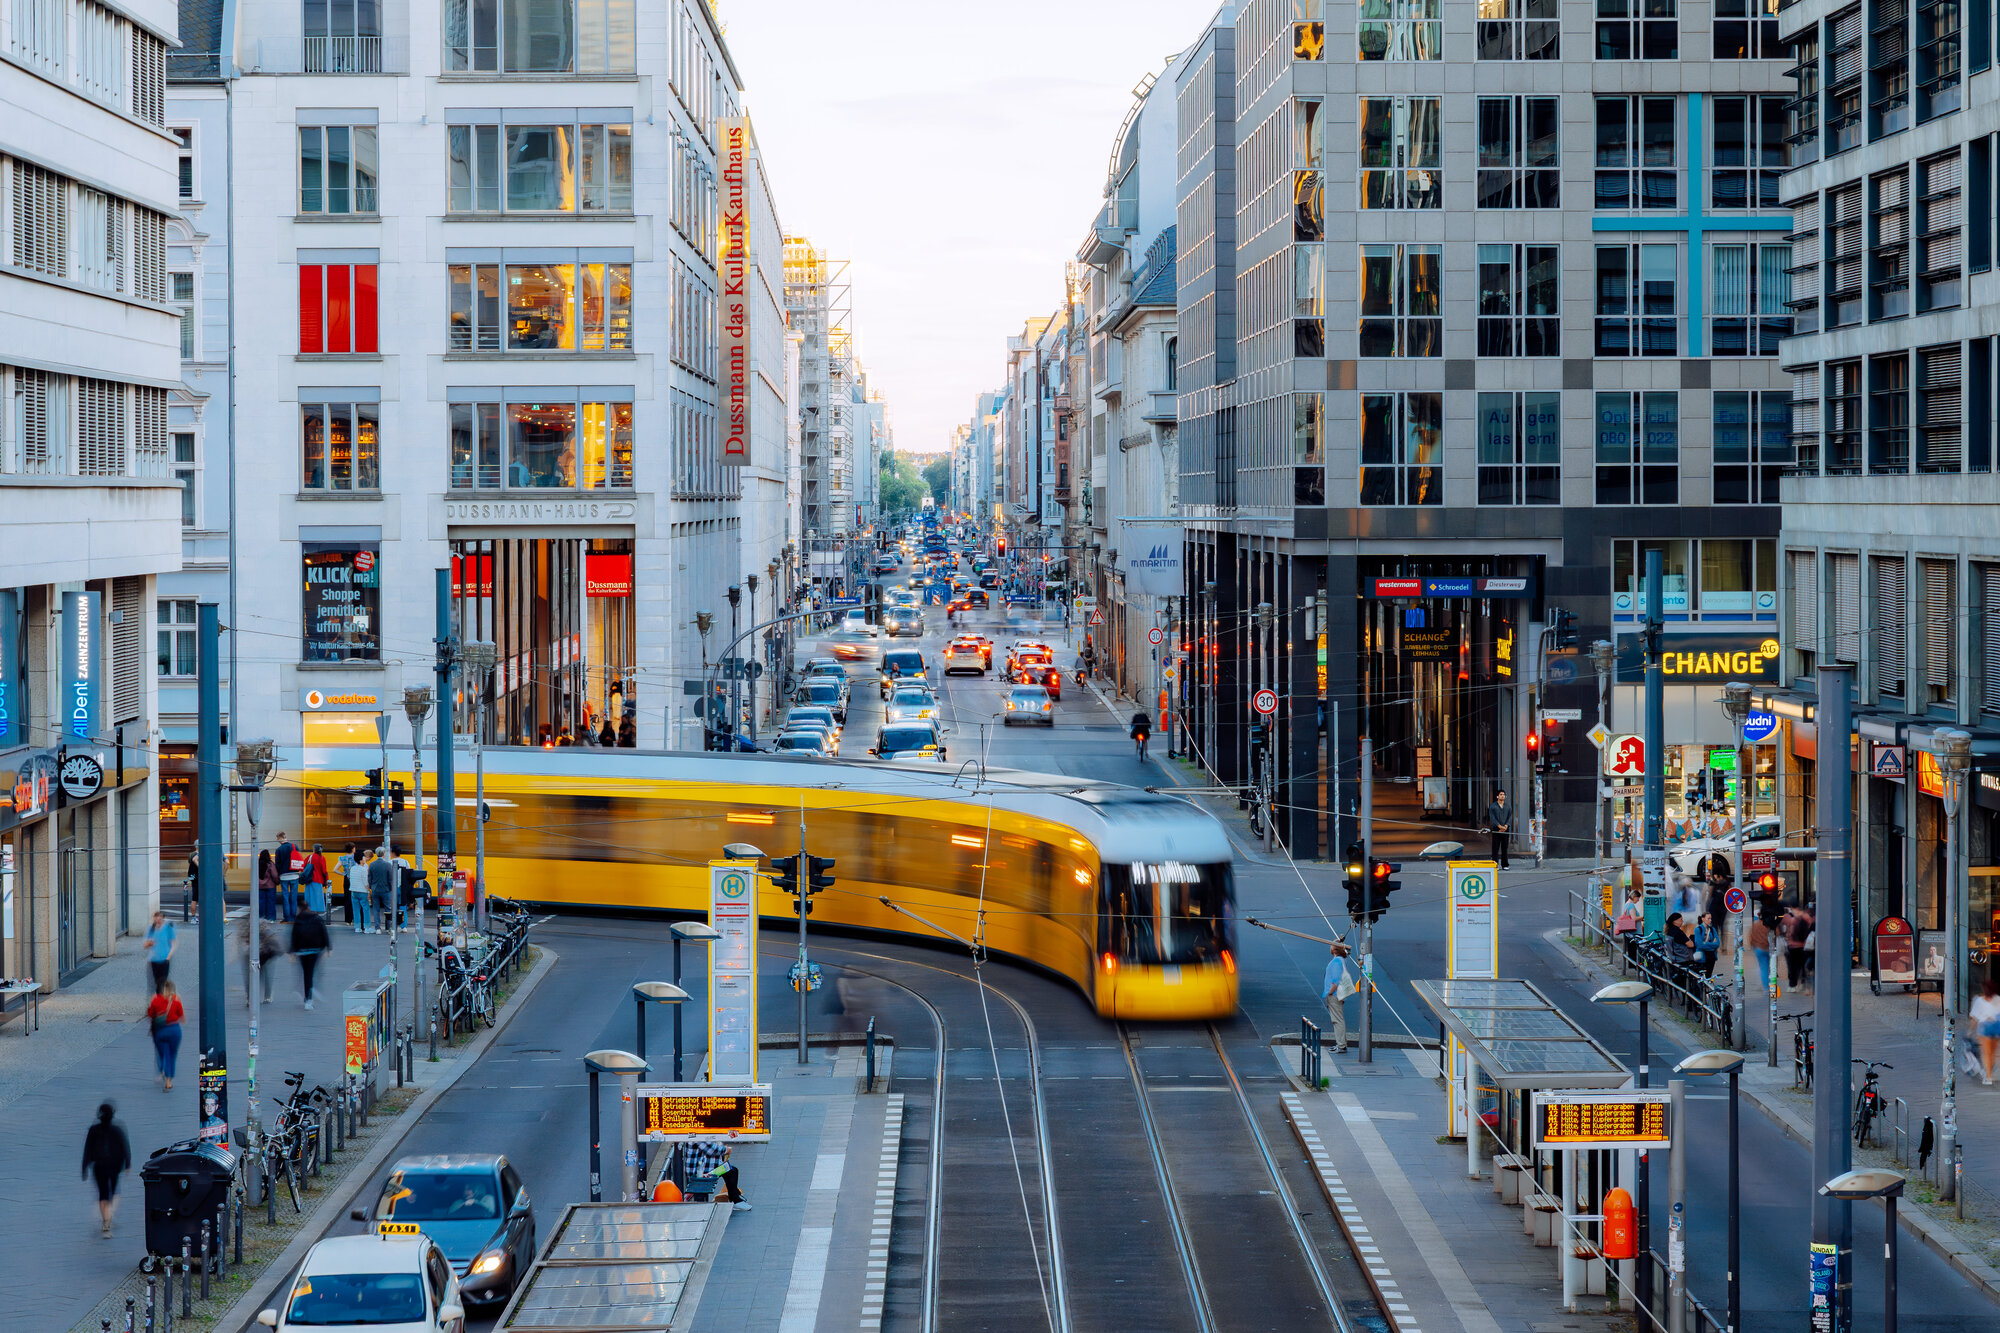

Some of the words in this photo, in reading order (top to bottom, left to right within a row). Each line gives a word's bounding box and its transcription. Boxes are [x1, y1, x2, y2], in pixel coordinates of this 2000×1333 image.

[723, 127, 744, 298] KulturKaufhaus
[725, 304, 744, 339] das
[725, 347, 744, 456] Dussmann
[447, 504, 599, 519] DUSSMANN-HAUS
[307, 567, 350, 583] KLICK
[353, 572, 374, 583] ma!
[588, 581, 628, 589] Dussmann
[322, 589, 361, 602] Shoppe
[317, 604, 366, 618] jemütlich
[317, 621, 341, 633] uffm
[343, 621, 367, 633] Sofa
[78, 595, 88, 679] ZAHNZENTRUM
[1644, 652, 1764, 674] CHANGE
[326, 693, 376, 705] vodafone
[1259, 696, 1273, 707] 30
[72, 681, 88, 739] AllDent
[1614, 787, 1642, 795] PHARMACY
[384, 1224, 412, 1233] TAXI
